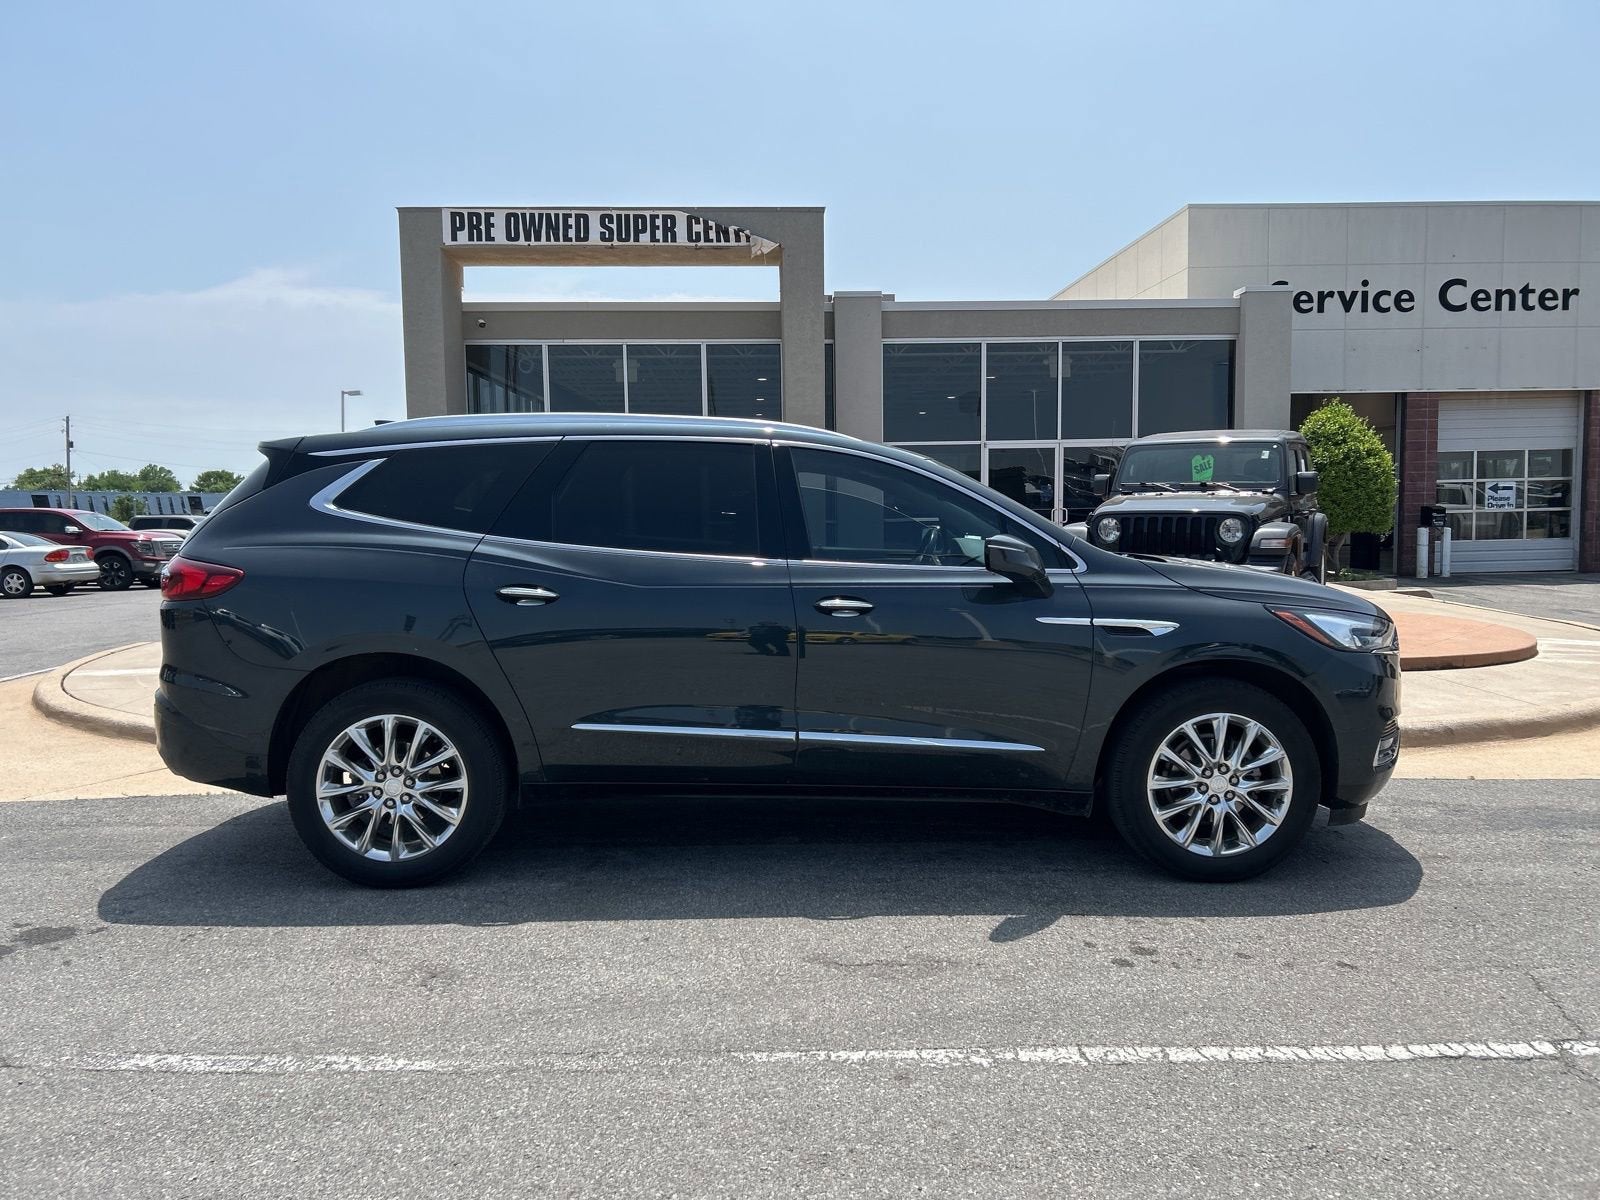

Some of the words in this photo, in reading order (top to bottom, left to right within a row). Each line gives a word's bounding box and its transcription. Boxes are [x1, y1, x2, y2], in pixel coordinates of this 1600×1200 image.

[450, 211, 496, 242] PRE
[504, 212, 590, 243] OWNED
[599, 213, 679, 243] SUPER
[686, 215, 751, 244] CENT
[1271, 279, 1415, 314] ervice
[1438, 278, 1580, 313] Center
[1193, 459, 1212, 475] SALE
